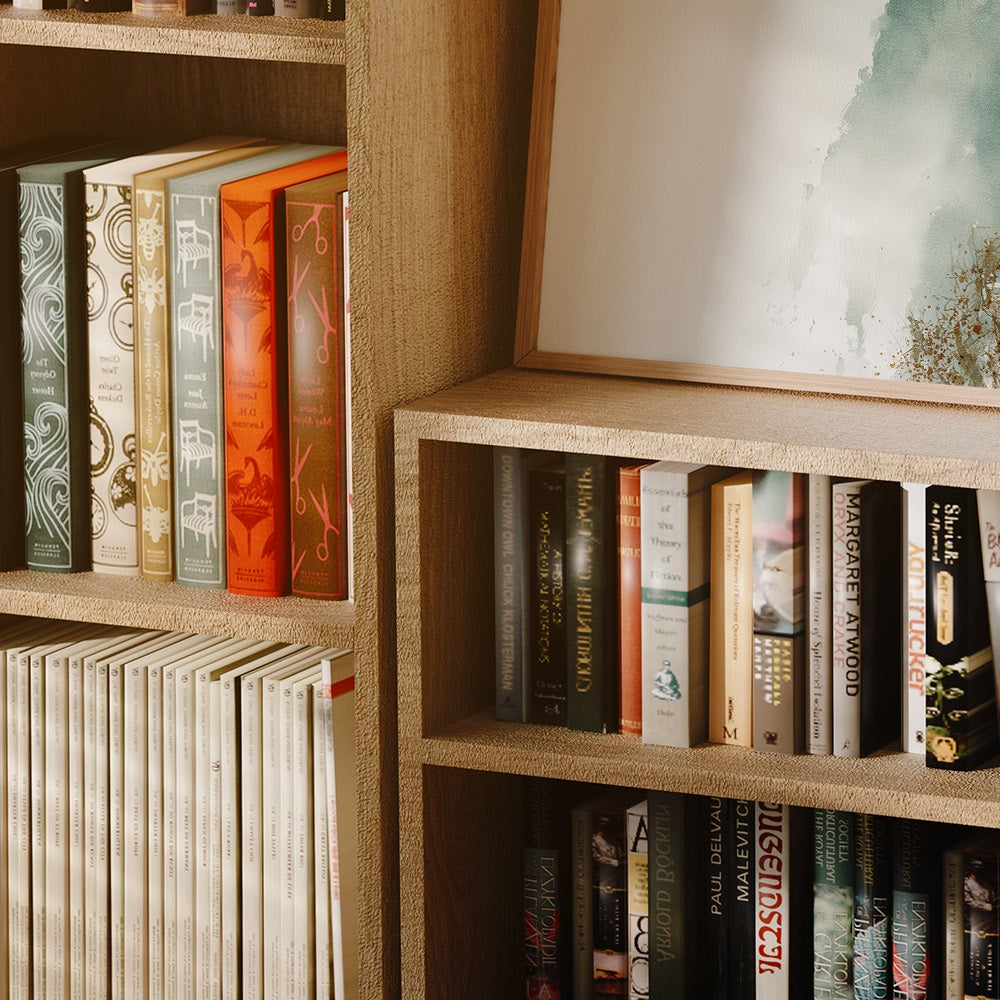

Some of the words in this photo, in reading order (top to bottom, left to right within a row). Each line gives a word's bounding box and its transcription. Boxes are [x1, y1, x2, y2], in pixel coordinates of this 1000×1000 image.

[501, 454, 514, 528] DOWNTOWN
[661, 503, 671, 513] of
[658, 521, 674, 532] the
[834, 491, 846, 550] ORYX
[502, 530, 513, 558] OWL
[650, 537, 682, 551] Theory
[661, 554, 671, 564] of
[845, 492, 860, 606] MARGARET
[501, 563, 513, 606] CHUCK
[834, 553, 845, 592] AND
[813, 591, 822, 625] House
[501, 609, 513, 691] KLOSTERMAN
[834, 599, 846, 669] CRAKE
[845, 612, 860, 697] ATWOOD
[811, 641, 823, 689] Splendid
[710, 871, 722, 915] PAUL
